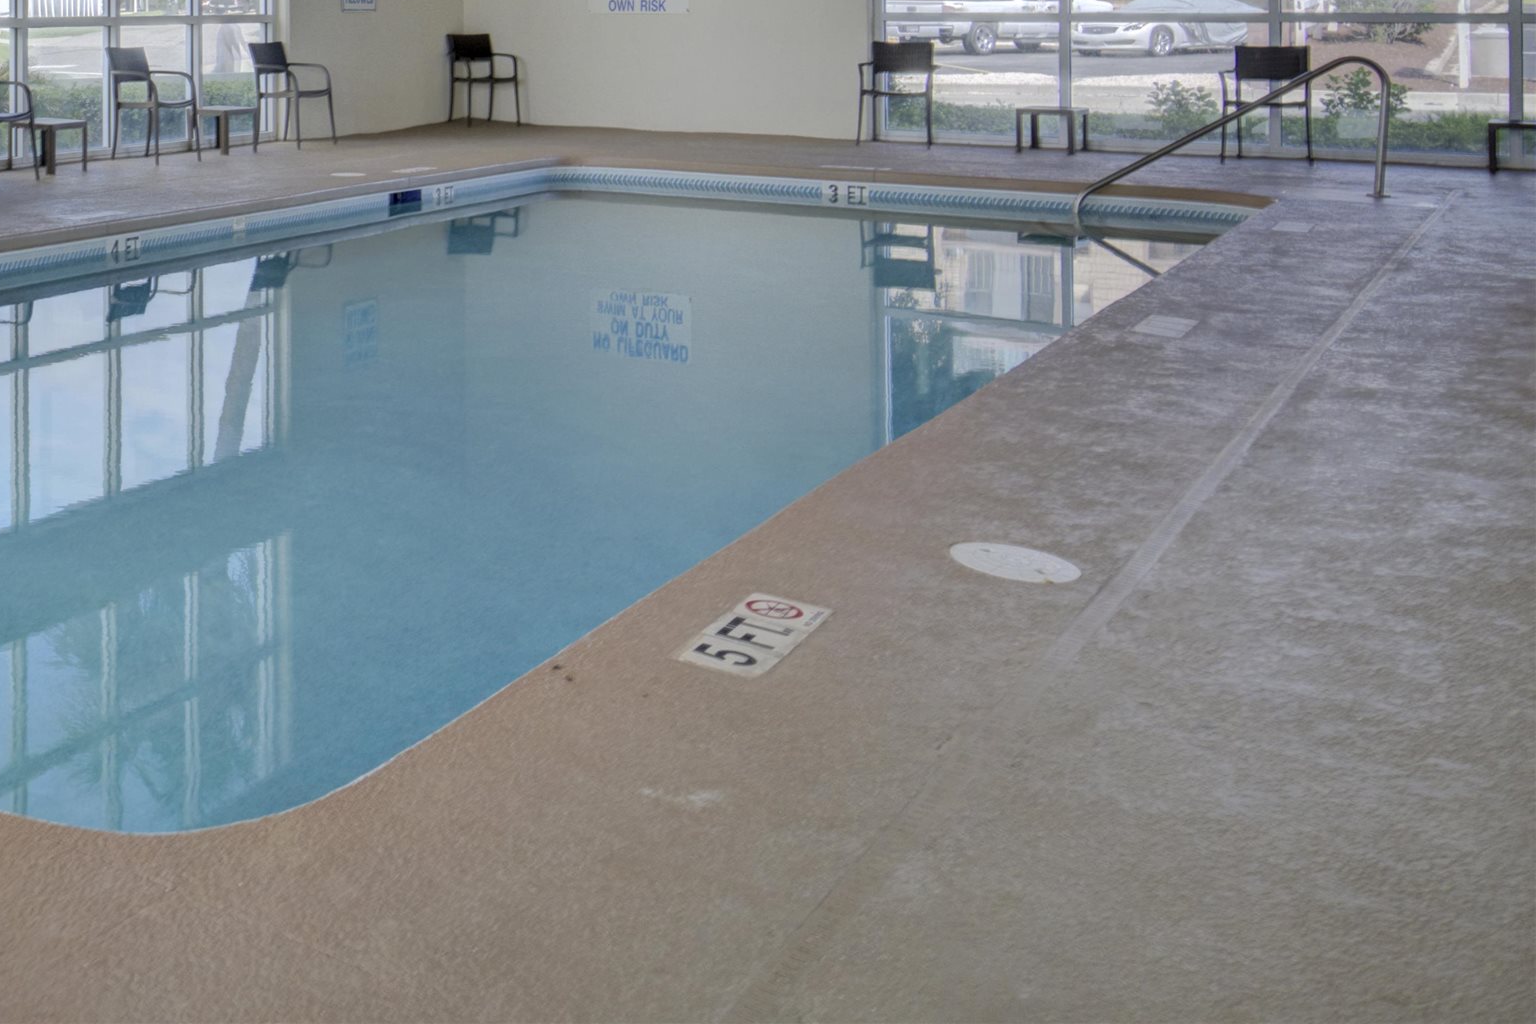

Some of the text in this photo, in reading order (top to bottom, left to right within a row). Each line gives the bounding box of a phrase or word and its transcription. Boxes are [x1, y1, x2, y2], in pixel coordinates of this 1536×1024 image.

[608, 0, 666, 12] OWN RISK
[692, 642, 757, 666] 5
